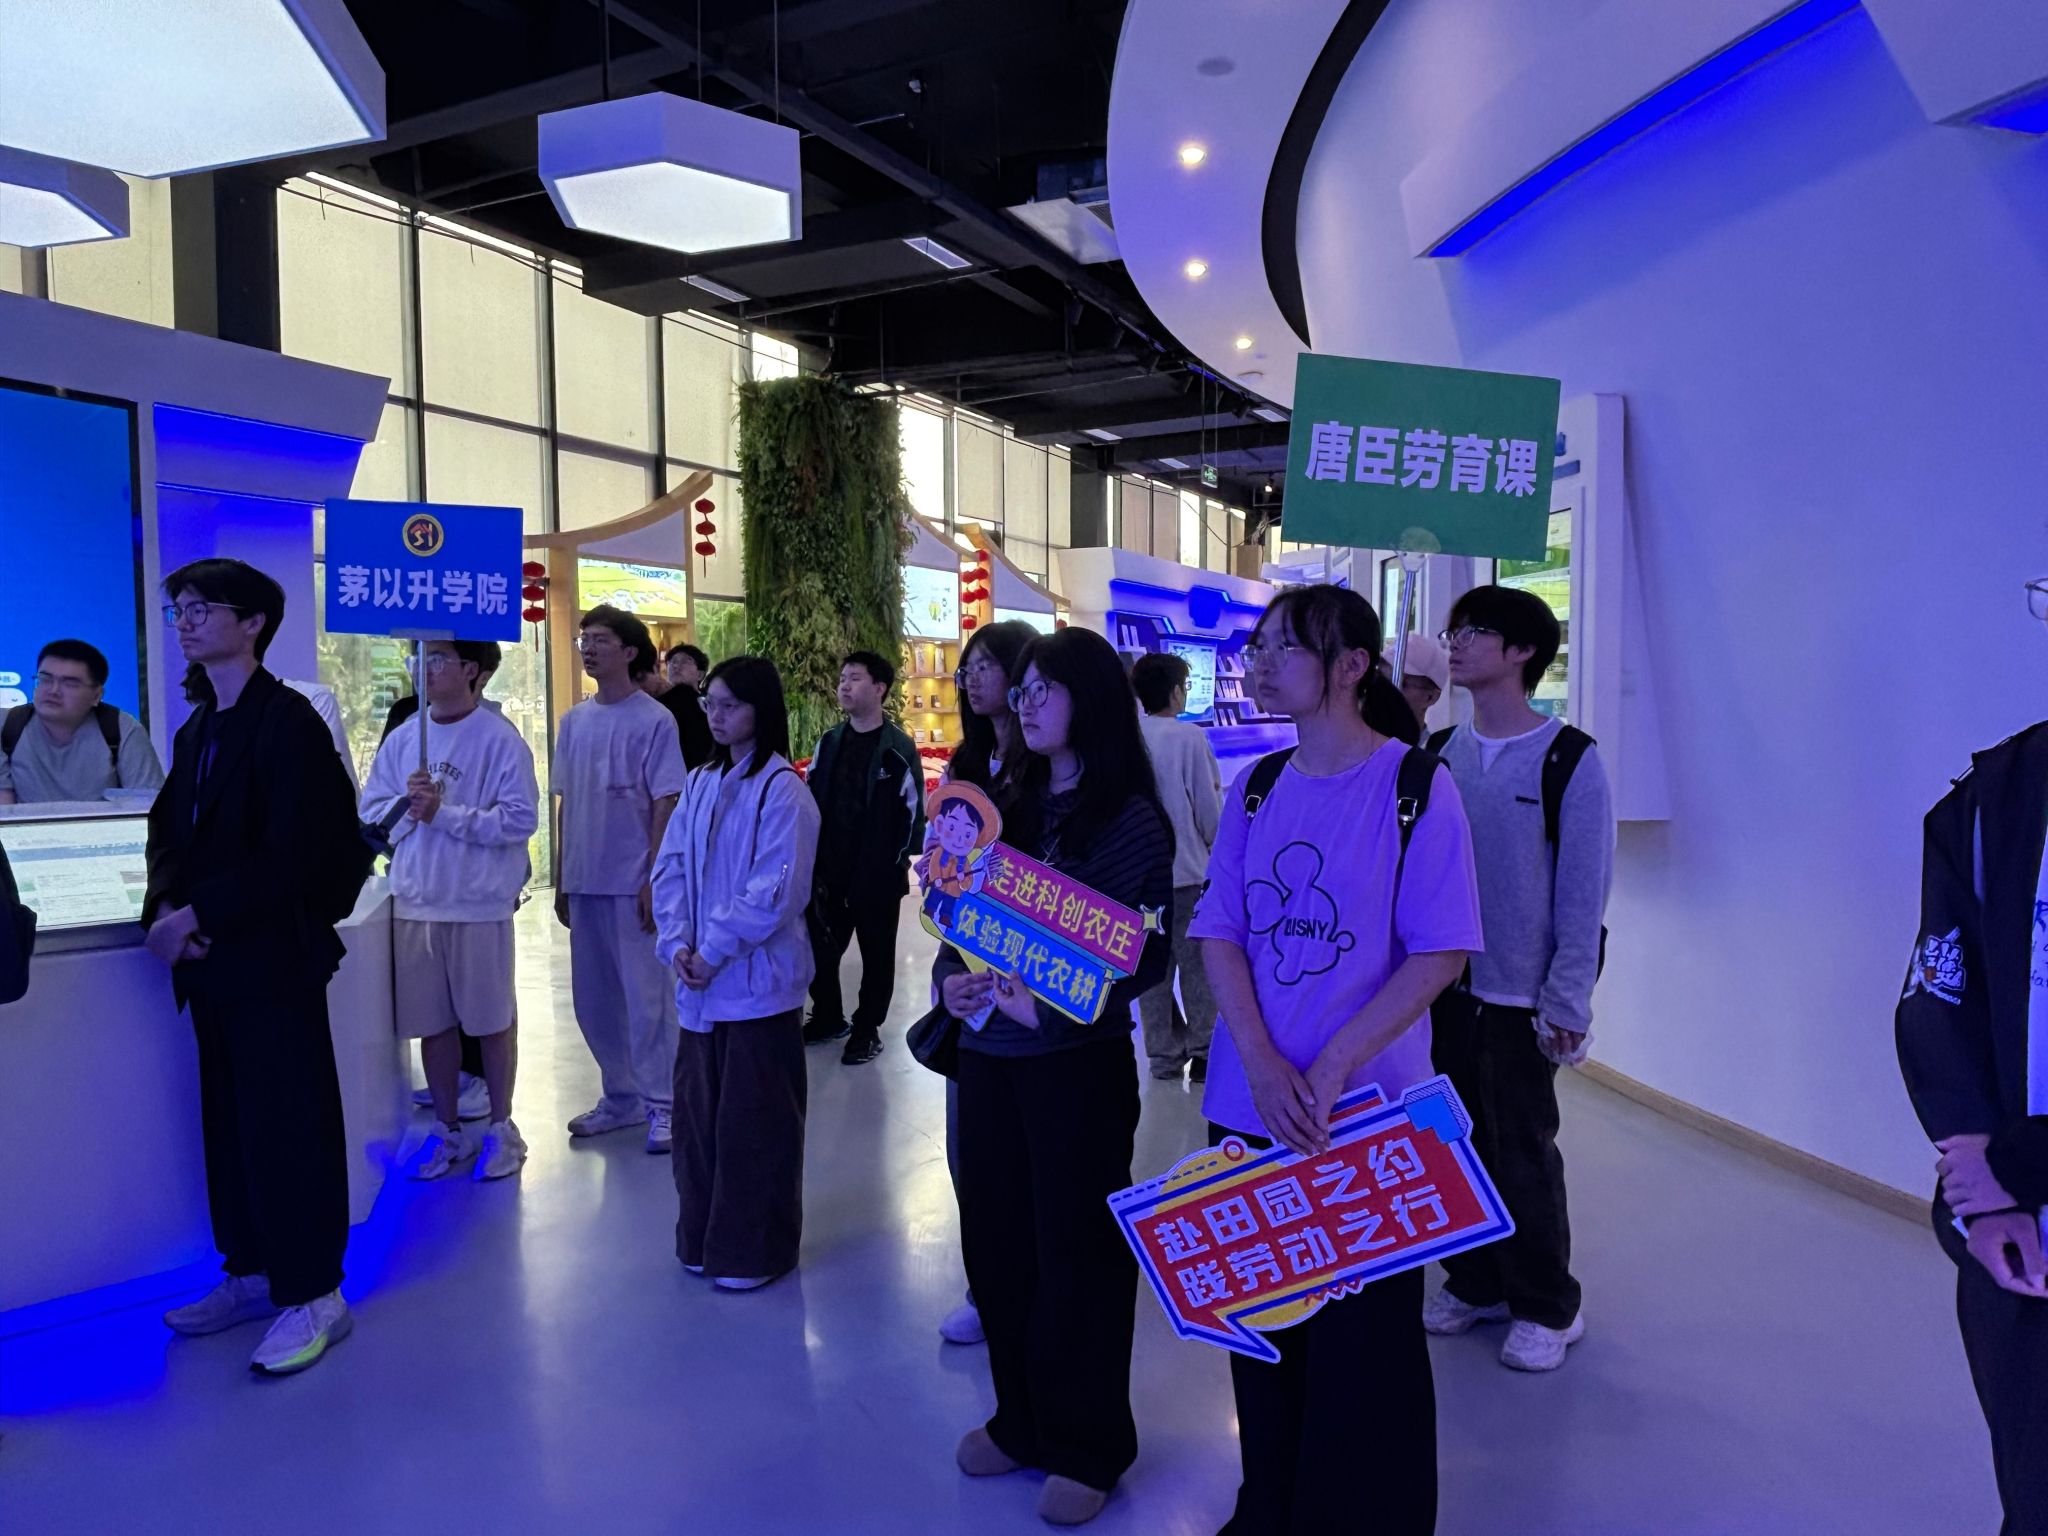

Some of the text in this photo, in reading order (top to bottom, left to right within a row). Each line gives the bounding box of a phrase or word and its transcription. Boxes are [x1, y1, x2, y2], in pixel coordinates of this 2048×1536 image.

[1304, 421, 1538, 497] 唐臣劳育课
[338, 564, 508, 616] 茅以升学院
[428, 761, 463, 781] LETES
[955, 904, 1098, 1011] 体验现代农耕
[991, 857, 1137, 961] 走进科创农庄
[1154, 1137, 1426, 1264] 赴田园之约
[1176, 1184, 1450, 1308] 践劳动之行
